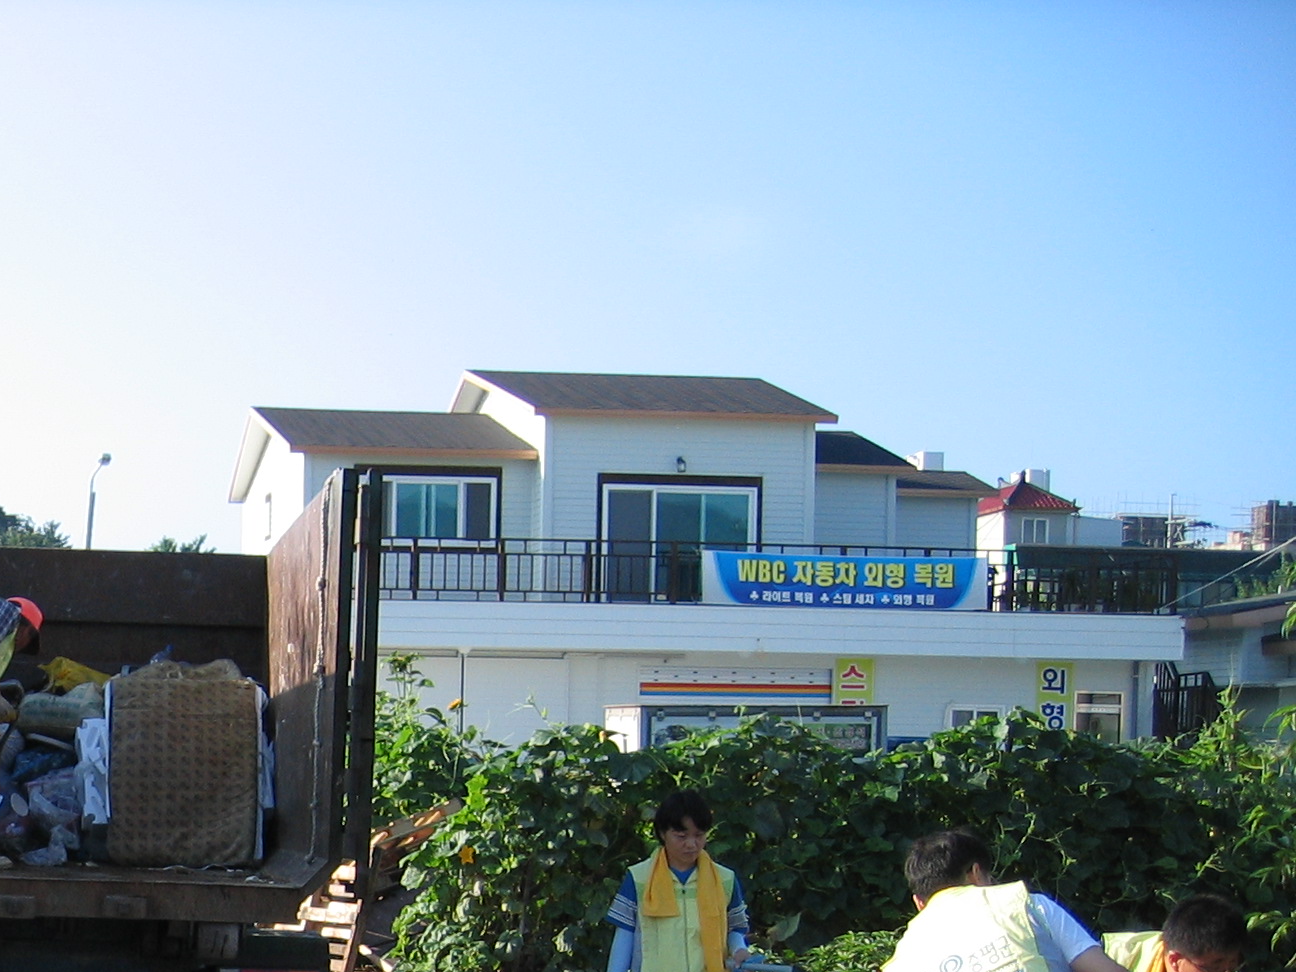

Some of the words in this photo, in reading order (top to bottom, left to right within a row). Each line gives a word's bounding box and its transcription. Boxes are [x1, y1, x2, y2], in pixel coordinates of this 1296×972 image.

[737, 559, 786, 583] WBC
[792, 561, 857, 587] 자동차
[864, 563, 905, 588] 외형
[914, 563, 954, 588] 복원
[840, 665, 866, 705] 스
[1041, 668, 1065, 731] 외형
